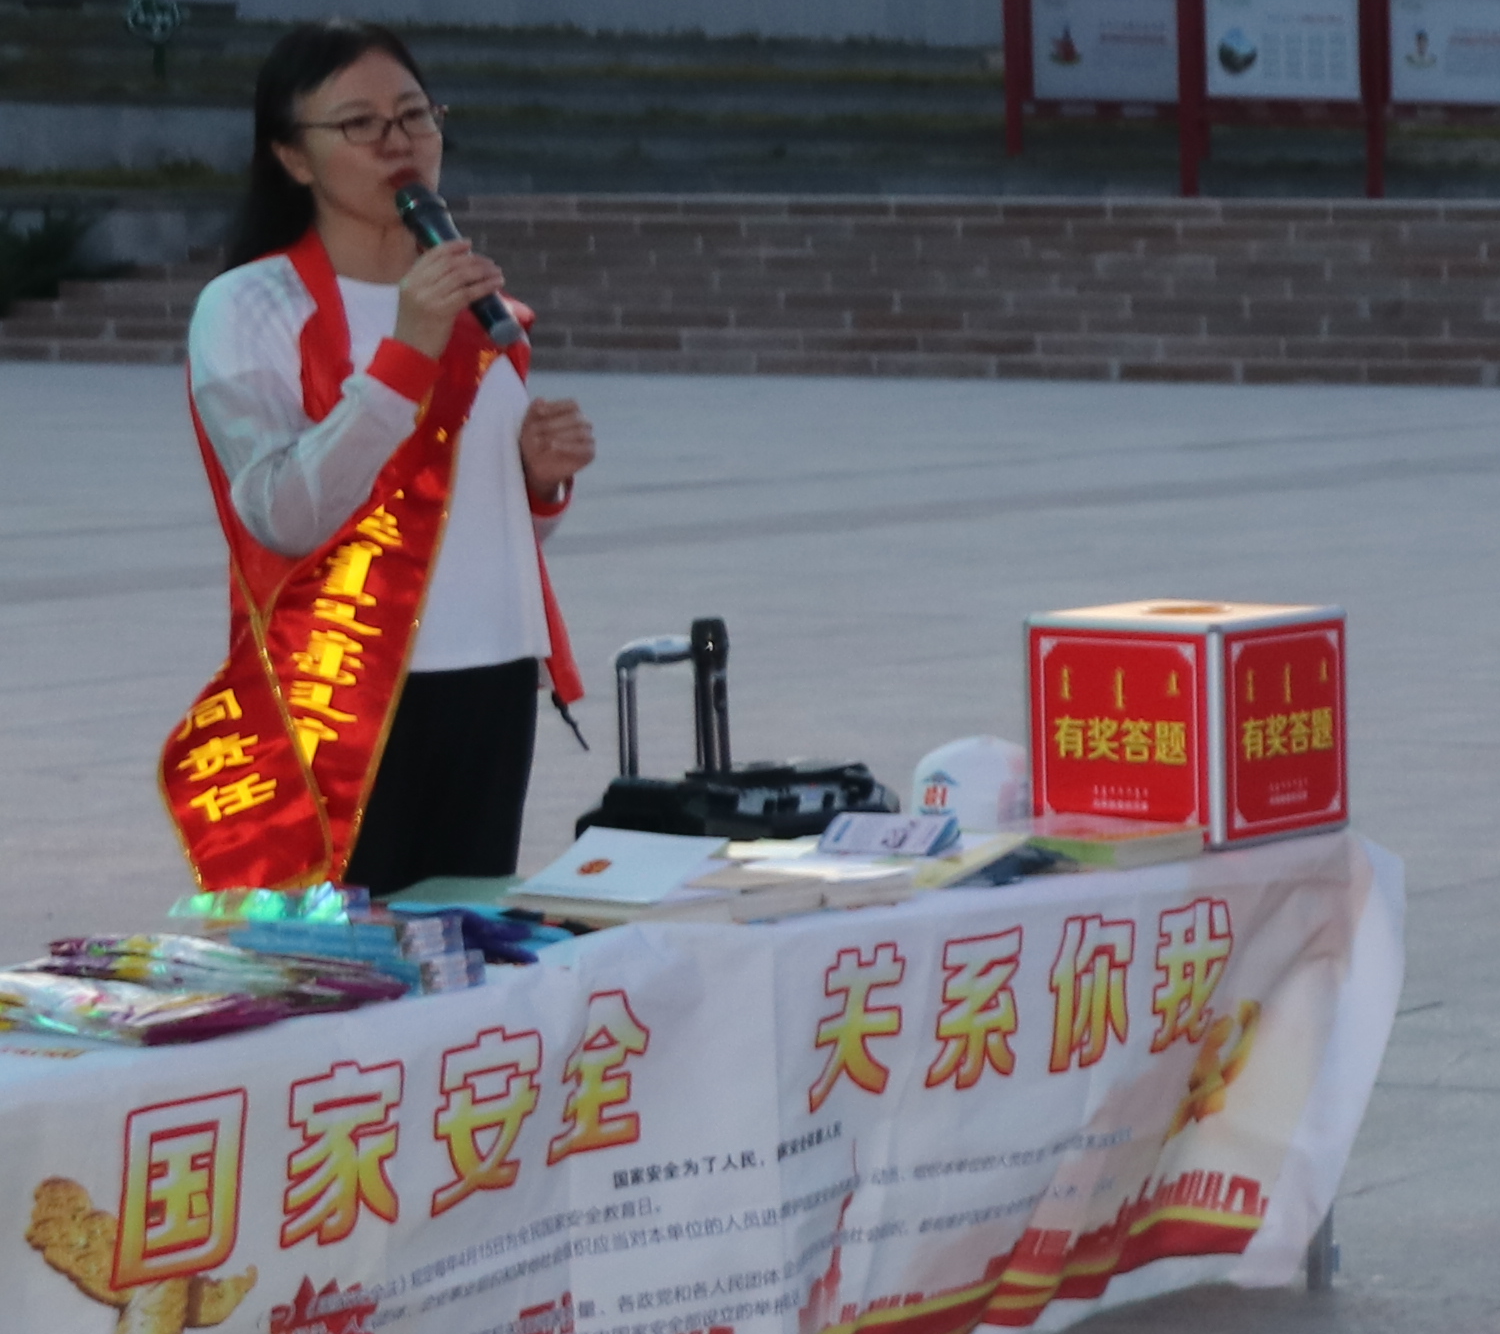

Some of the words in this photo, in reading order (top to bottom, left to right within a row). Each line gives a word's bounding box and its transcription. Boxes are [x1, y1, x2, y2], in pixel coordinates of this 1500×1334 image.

[1055, 716, 1187, 766] 有奖答题
[1243, 706, 1334, 762] 有奖答题
[113, 990, 652, 1290] 国家安全
[807, 897, 1233, 1114] 关系你我
